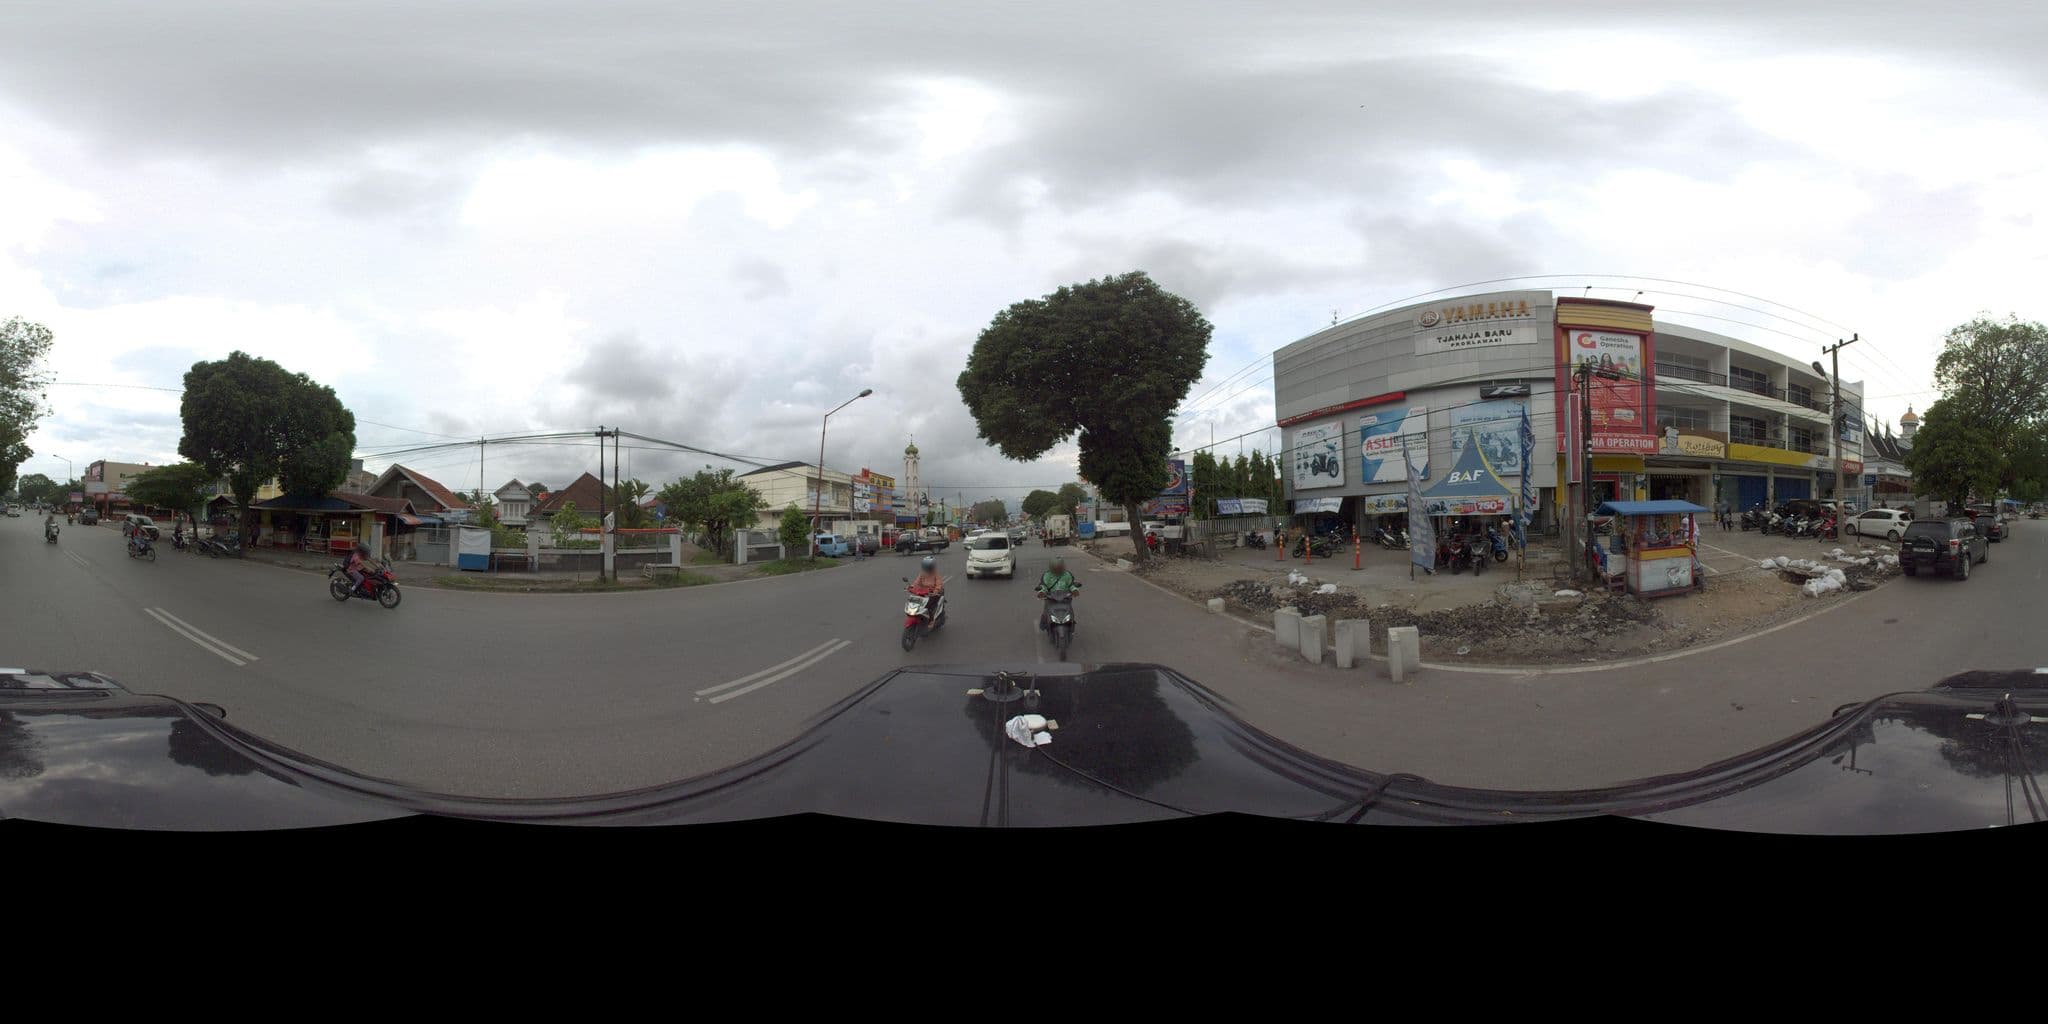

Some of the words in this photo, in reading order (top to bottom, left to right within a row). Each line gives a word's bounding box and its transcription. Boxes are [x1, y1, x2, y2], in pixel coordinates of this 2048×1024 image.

[1443, 301, 1530, 323] YAMAHA
[1437, 332, 1480, 343] TJAHAJA
[1485, 329, 1512, 338] BARU
[1600, 335, 1628, 343] Ganesha
[1600, 341, 1634, 351] Operation
[1366, 437, 1393, 451] ASLI
[1607, 438, 1653, 449] OPERATION
[1448, 470, 1485, 483] BAF
